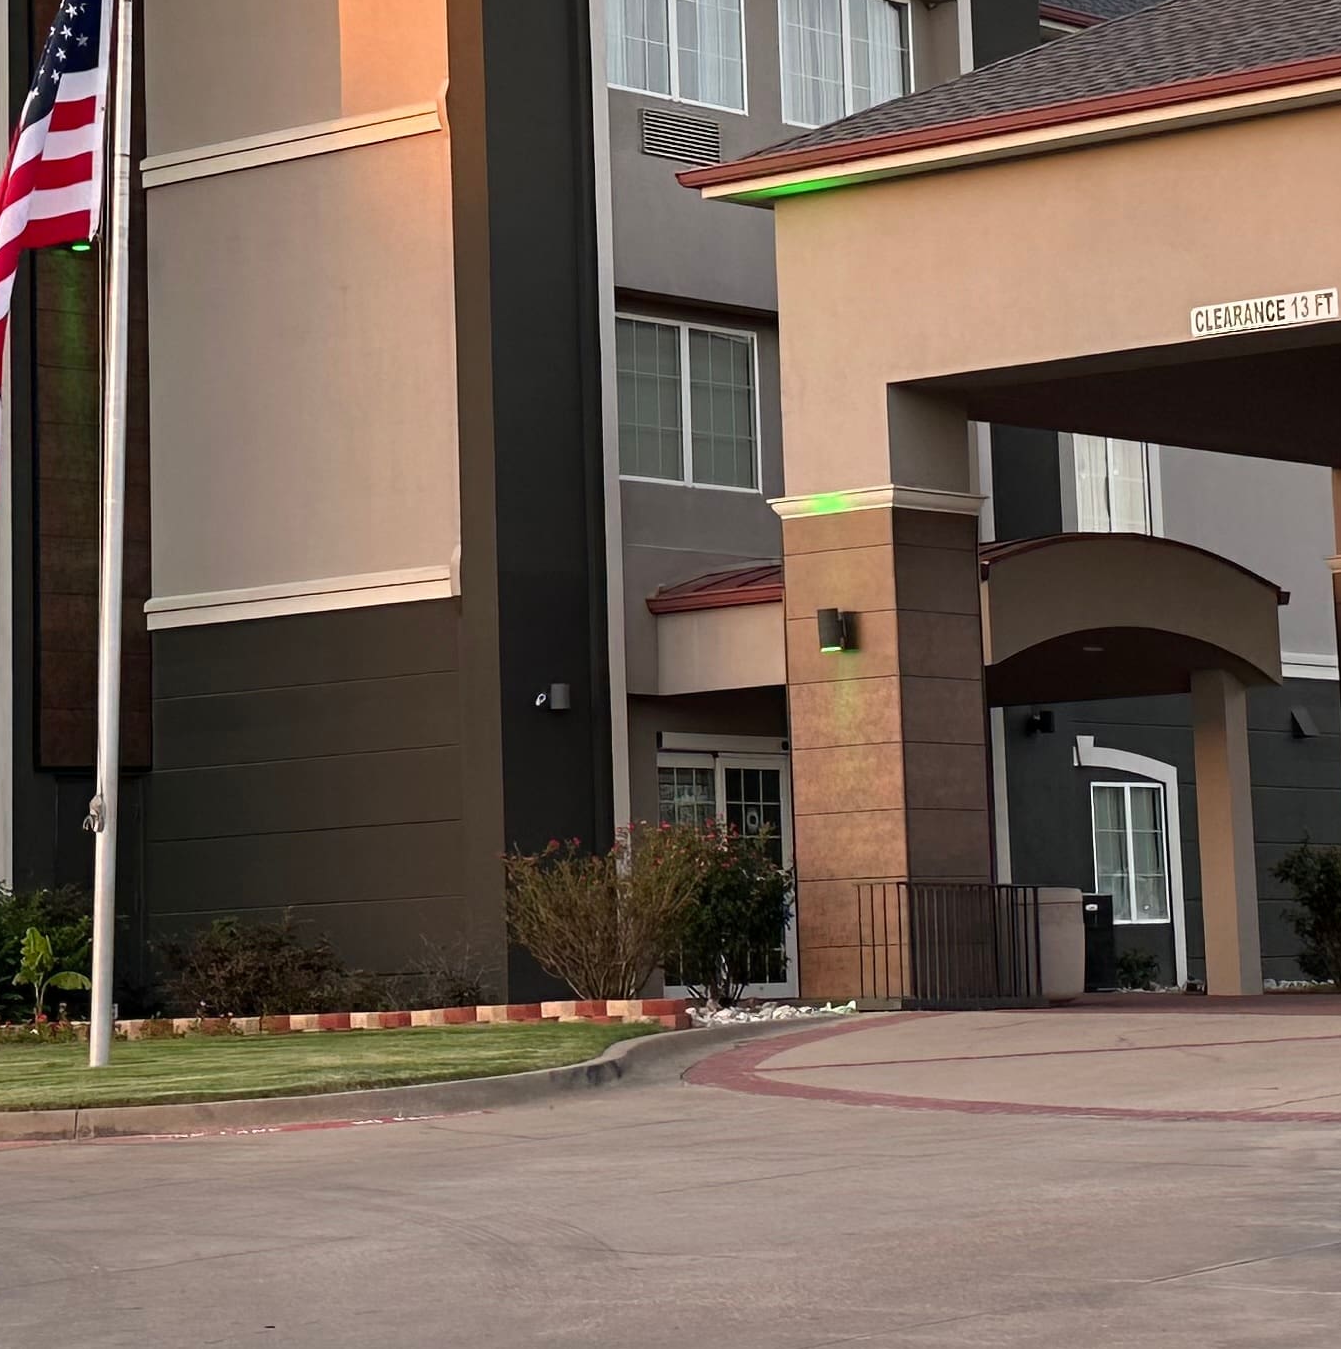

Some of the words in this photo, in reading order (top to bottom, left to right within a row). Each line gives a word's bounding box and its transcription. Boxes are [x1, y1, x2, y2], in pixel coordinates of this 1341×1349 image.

[1194, 299, 1286, 333] CLEARANCE
[1291, 294, 1310, 319] 13
[1314, 291, 1334, 316] FT
